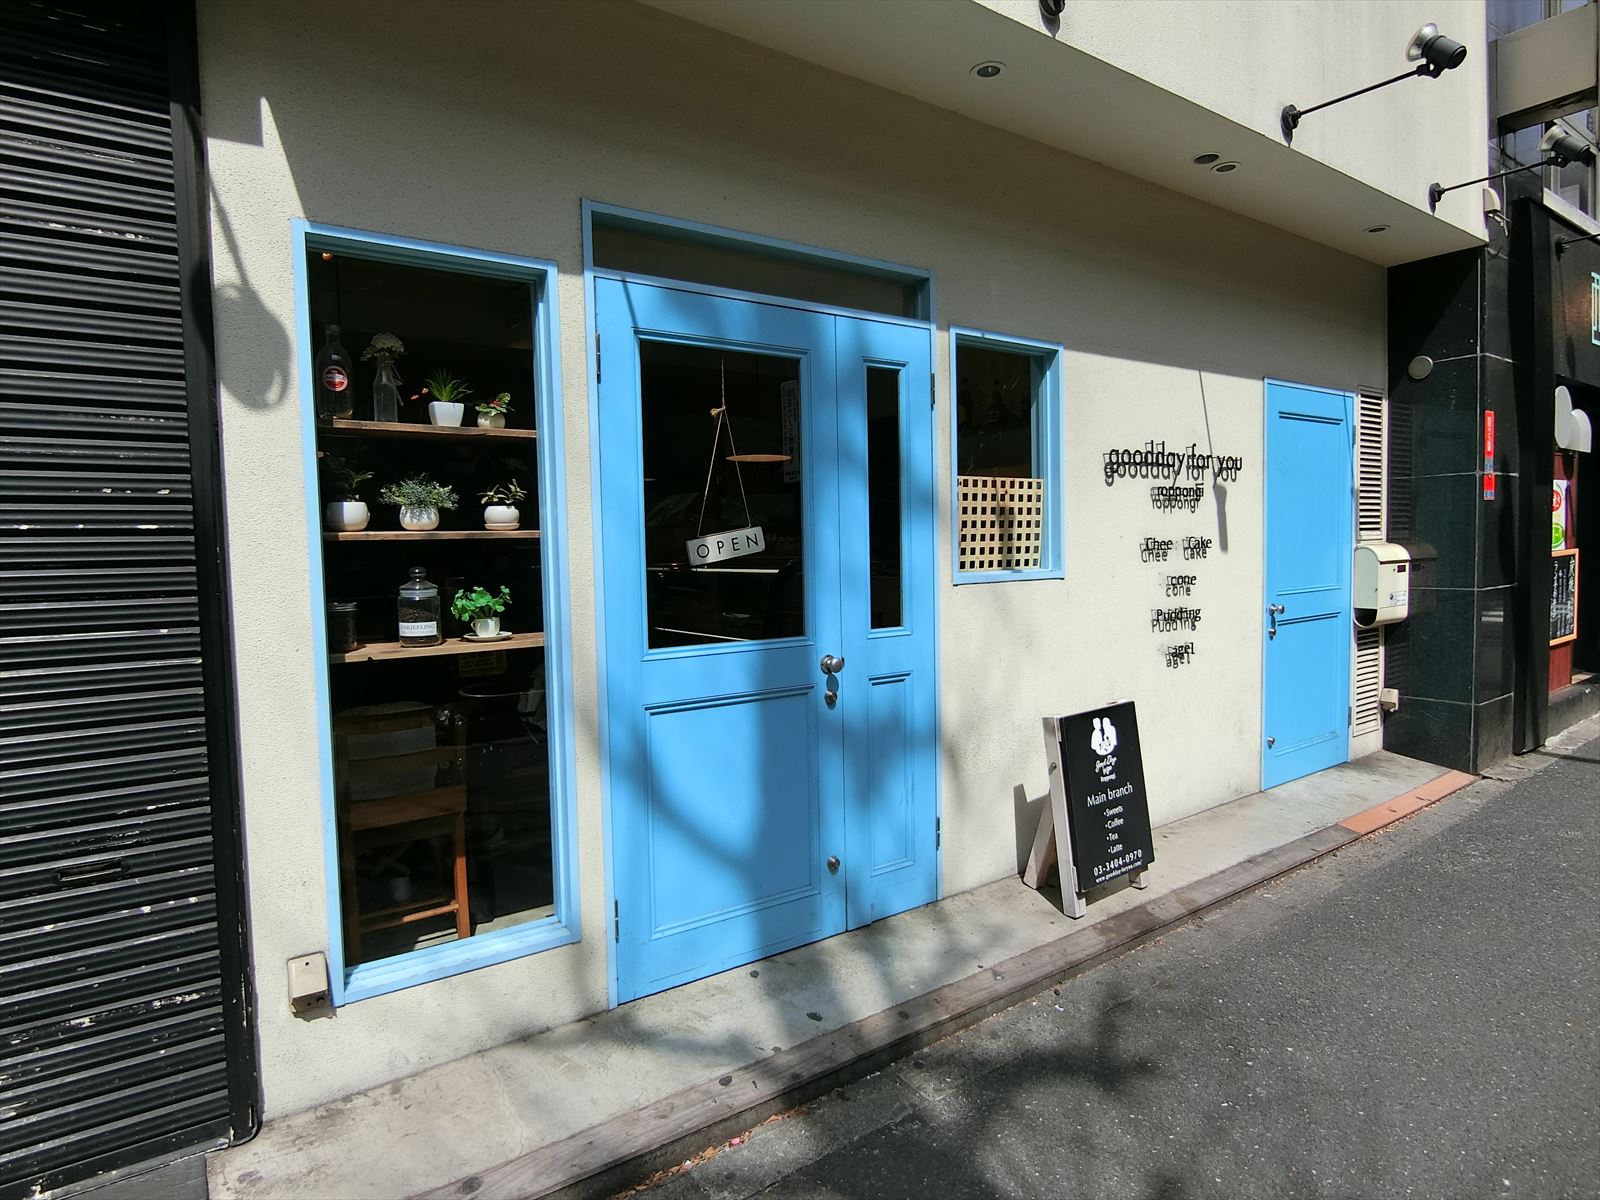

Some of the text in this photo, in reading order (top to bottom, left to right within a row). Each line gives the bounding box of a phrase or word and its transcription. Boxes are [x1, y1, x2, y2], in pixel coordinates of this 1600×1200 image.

[1190, 443, 1212, 469] for
[1216, 454, 1243, 477] you
[696, 533, 759, 558] OPEN
[1145, 536, 1212, 550] Chee Cake
[1156, 607, 1201, 622] Pudding
[1171, 642, 1195, 657] agel
[1087, 782, 1133, 807] Main branch
[1107, 817, 1124, 829] Coffee
[1108, 832, 1118, 841] Tea
[1093, 849, 1142, 876] 03-3404-0970
